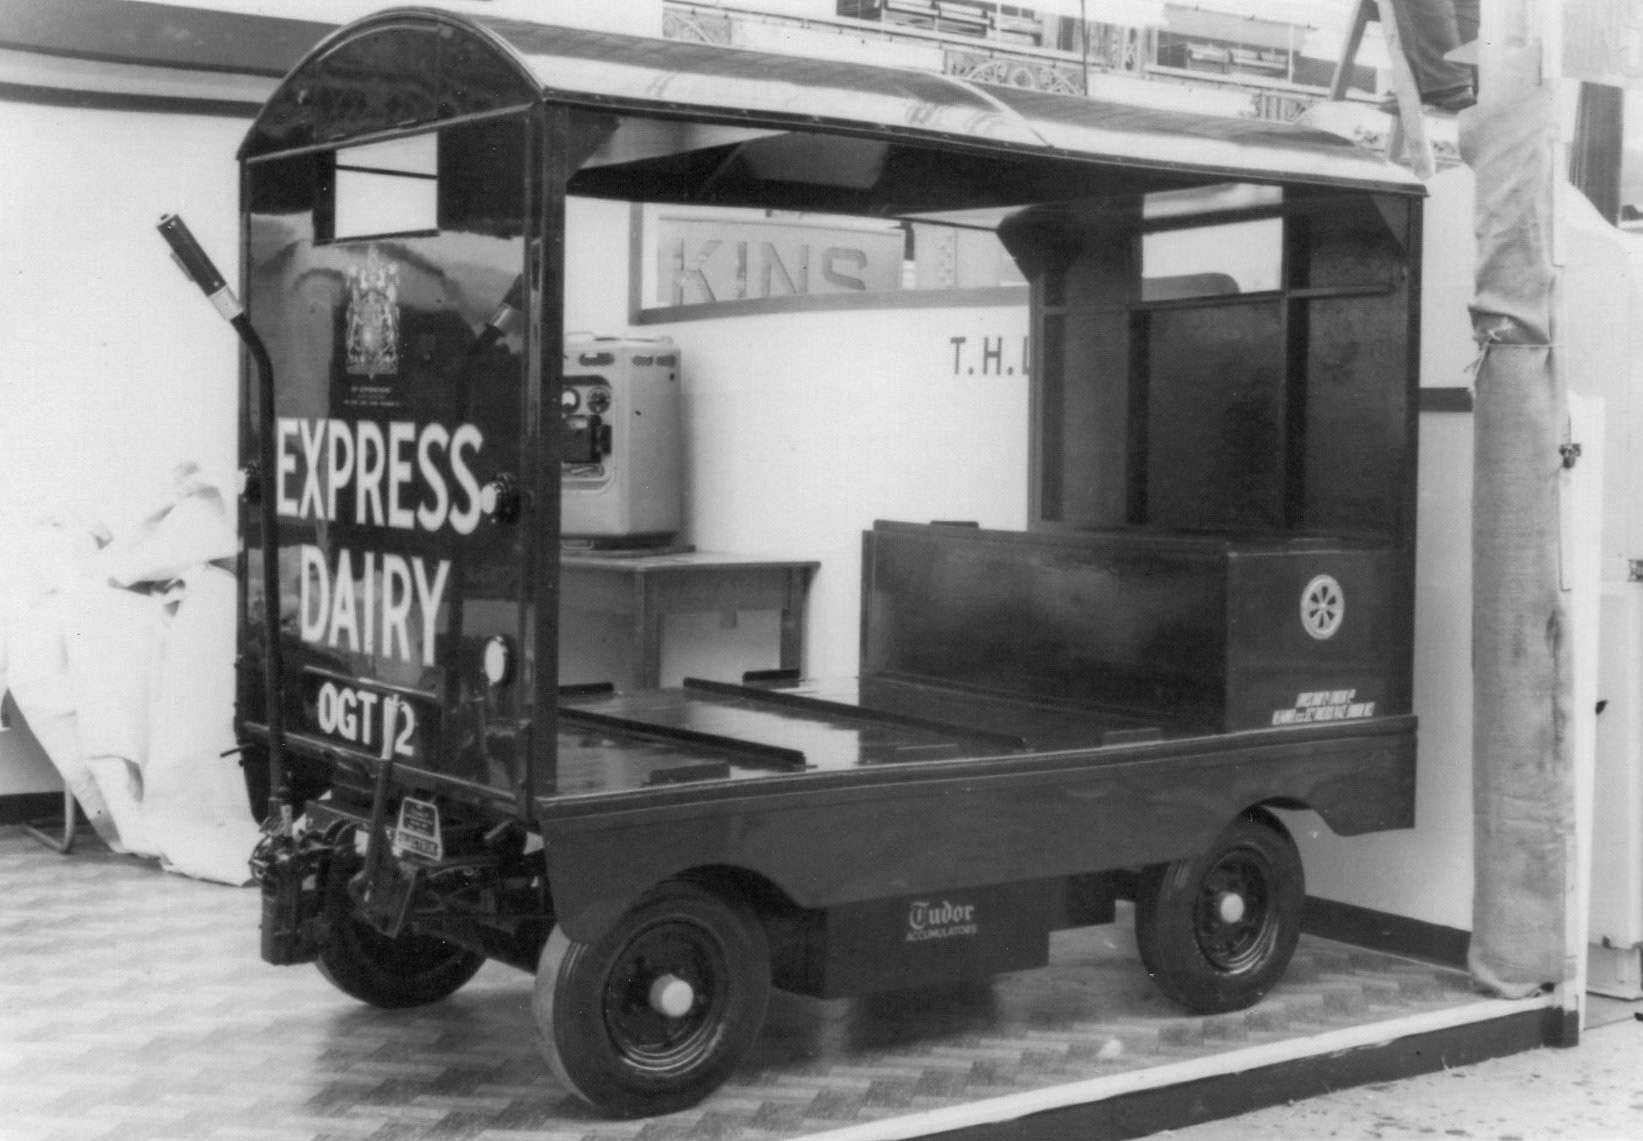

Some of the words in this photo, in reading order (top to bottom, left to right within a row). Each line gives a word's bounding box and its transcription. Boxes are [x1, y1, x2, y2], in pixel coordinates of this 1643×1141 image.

[276, 417, 483, 535] EXPRESS
[301, 544, 451, 667] DAIRY
[318, 682, 378, 745] OGT
[908, 900, 975, 930] Tudor
